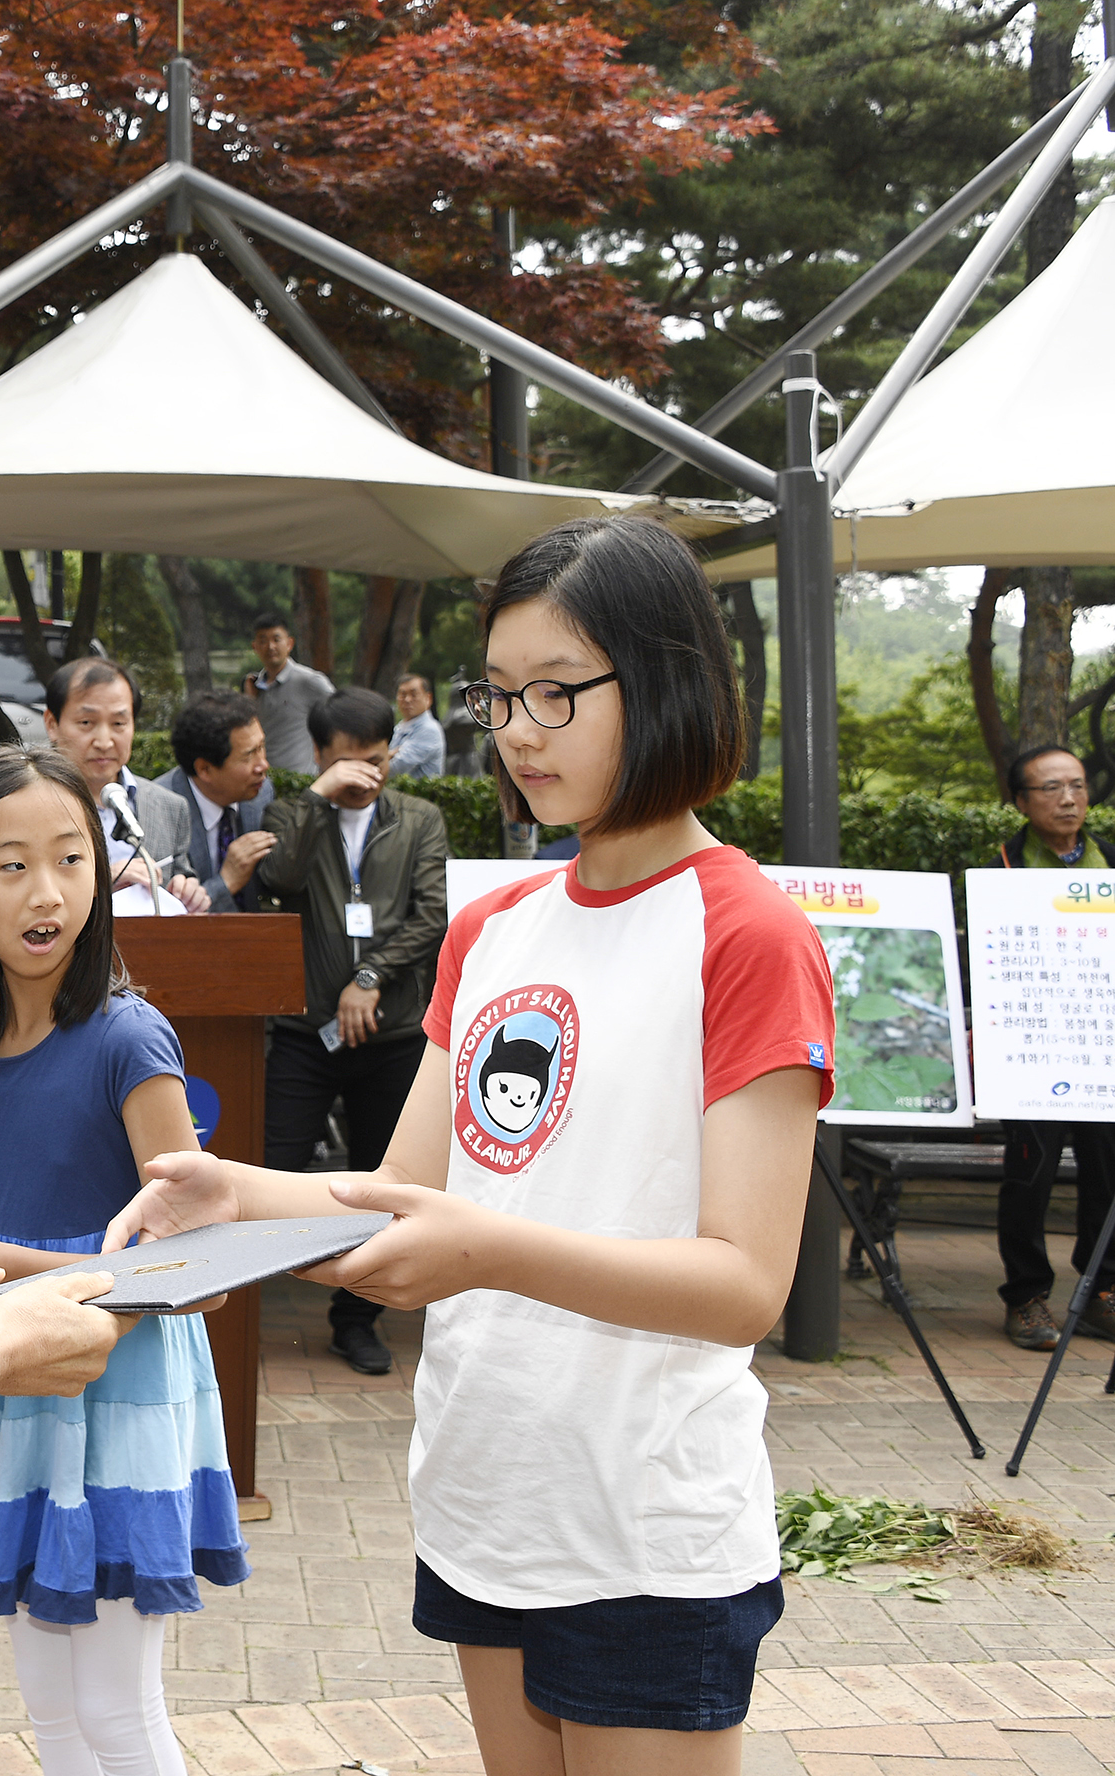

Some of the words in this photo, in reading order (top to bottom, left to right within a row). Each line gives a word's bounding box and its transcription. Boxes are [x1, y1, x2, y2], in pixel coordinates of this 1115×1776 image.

[774, 879, 864, 907] 리방법
[505, 991, 544, 1013] IT'S
[540, 991, 569, 1021] ALL
[563, 1014, 574, 1060] YOU
[544, 1066, 572, 1129] HAVE
[462, 1123, 513, 1167] E.LAND
[513, 1143, 532, 1166] JR.
[540, 1135, 558, 1155] Good
[555, 1107, 574, 1137] Enough
